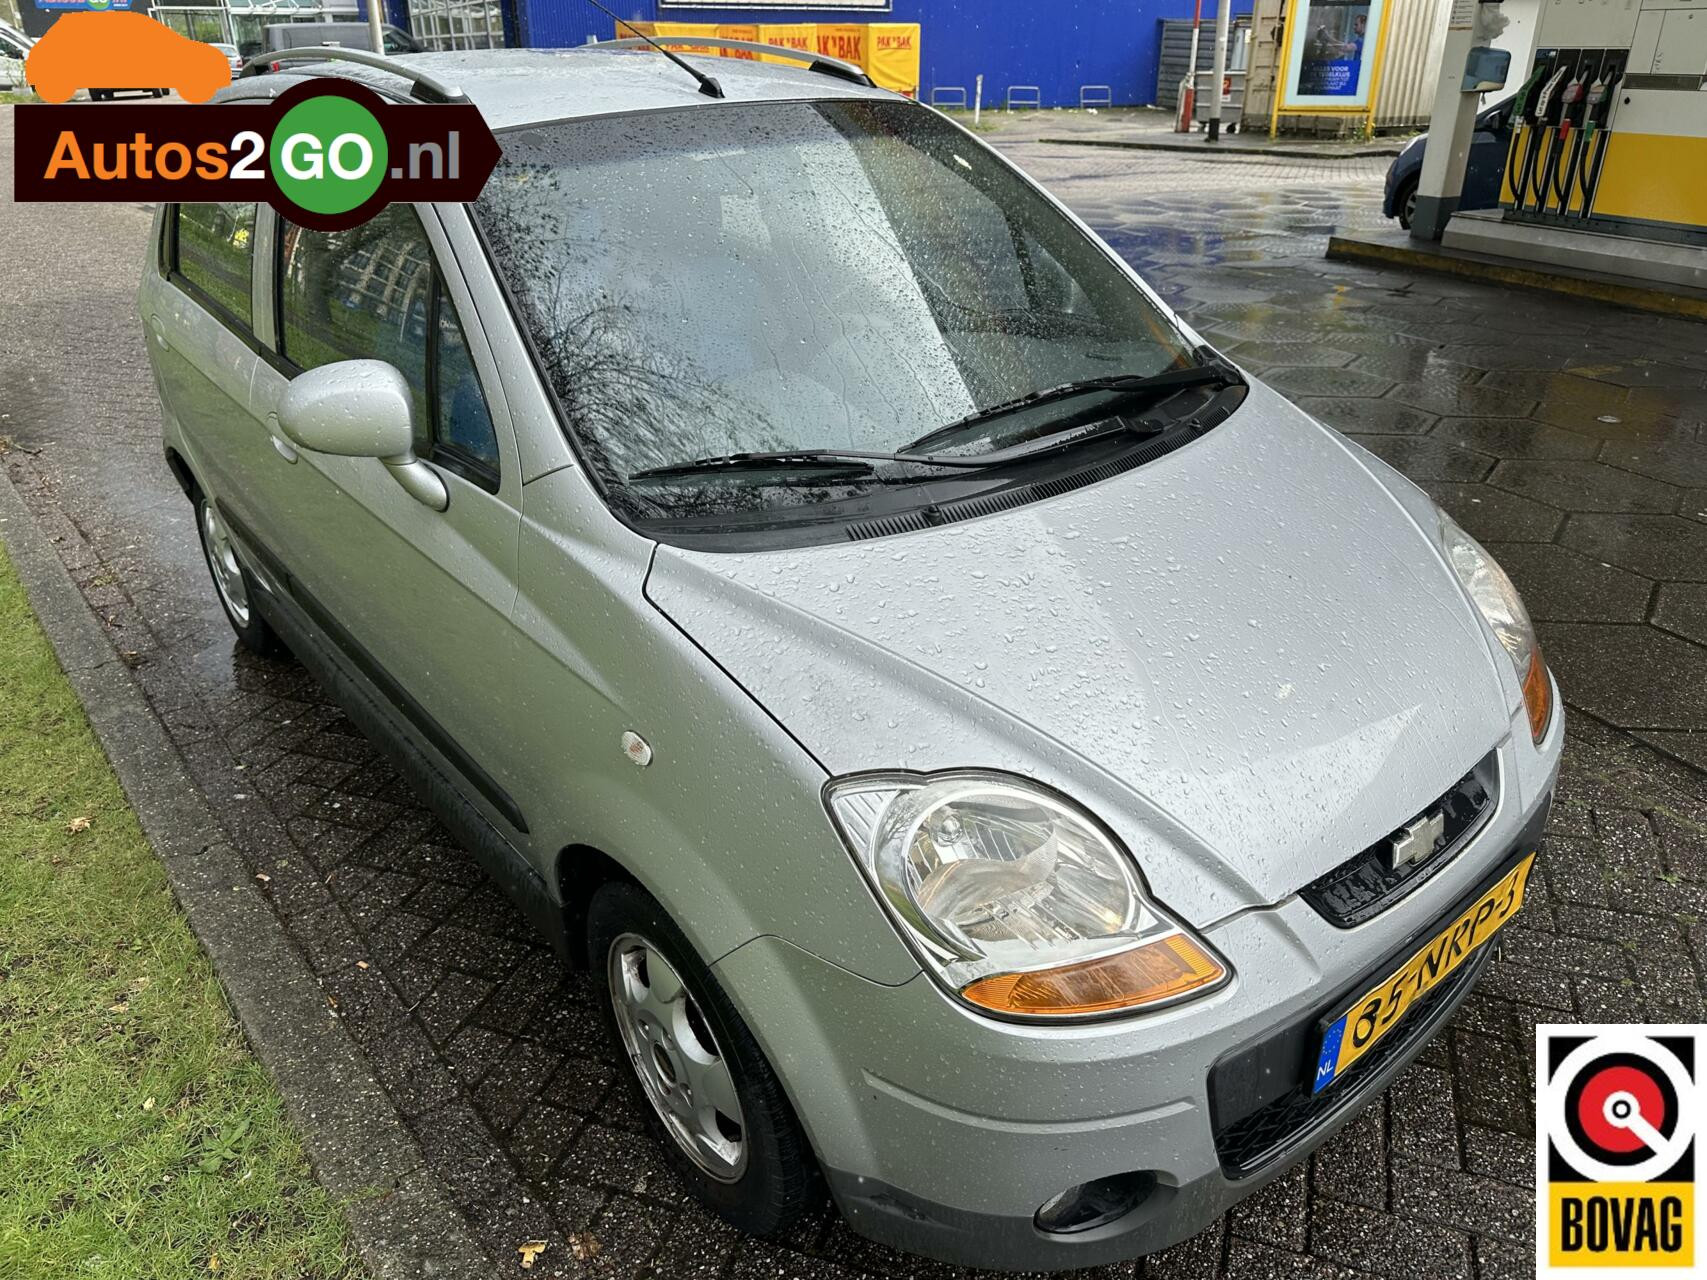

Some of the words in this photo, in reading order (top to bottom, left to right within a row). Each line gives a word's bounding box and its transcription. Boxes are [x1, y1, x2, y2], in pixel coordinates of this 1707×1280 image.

[838, 35, 861, 60] BAK
[877, 36, 891, 47] PAK
[896, 36, 912, 48] BAK
[1353, 870, 1519, 1048] 85-NRP-3
[1316, 1064, 1334, 1081] NL
